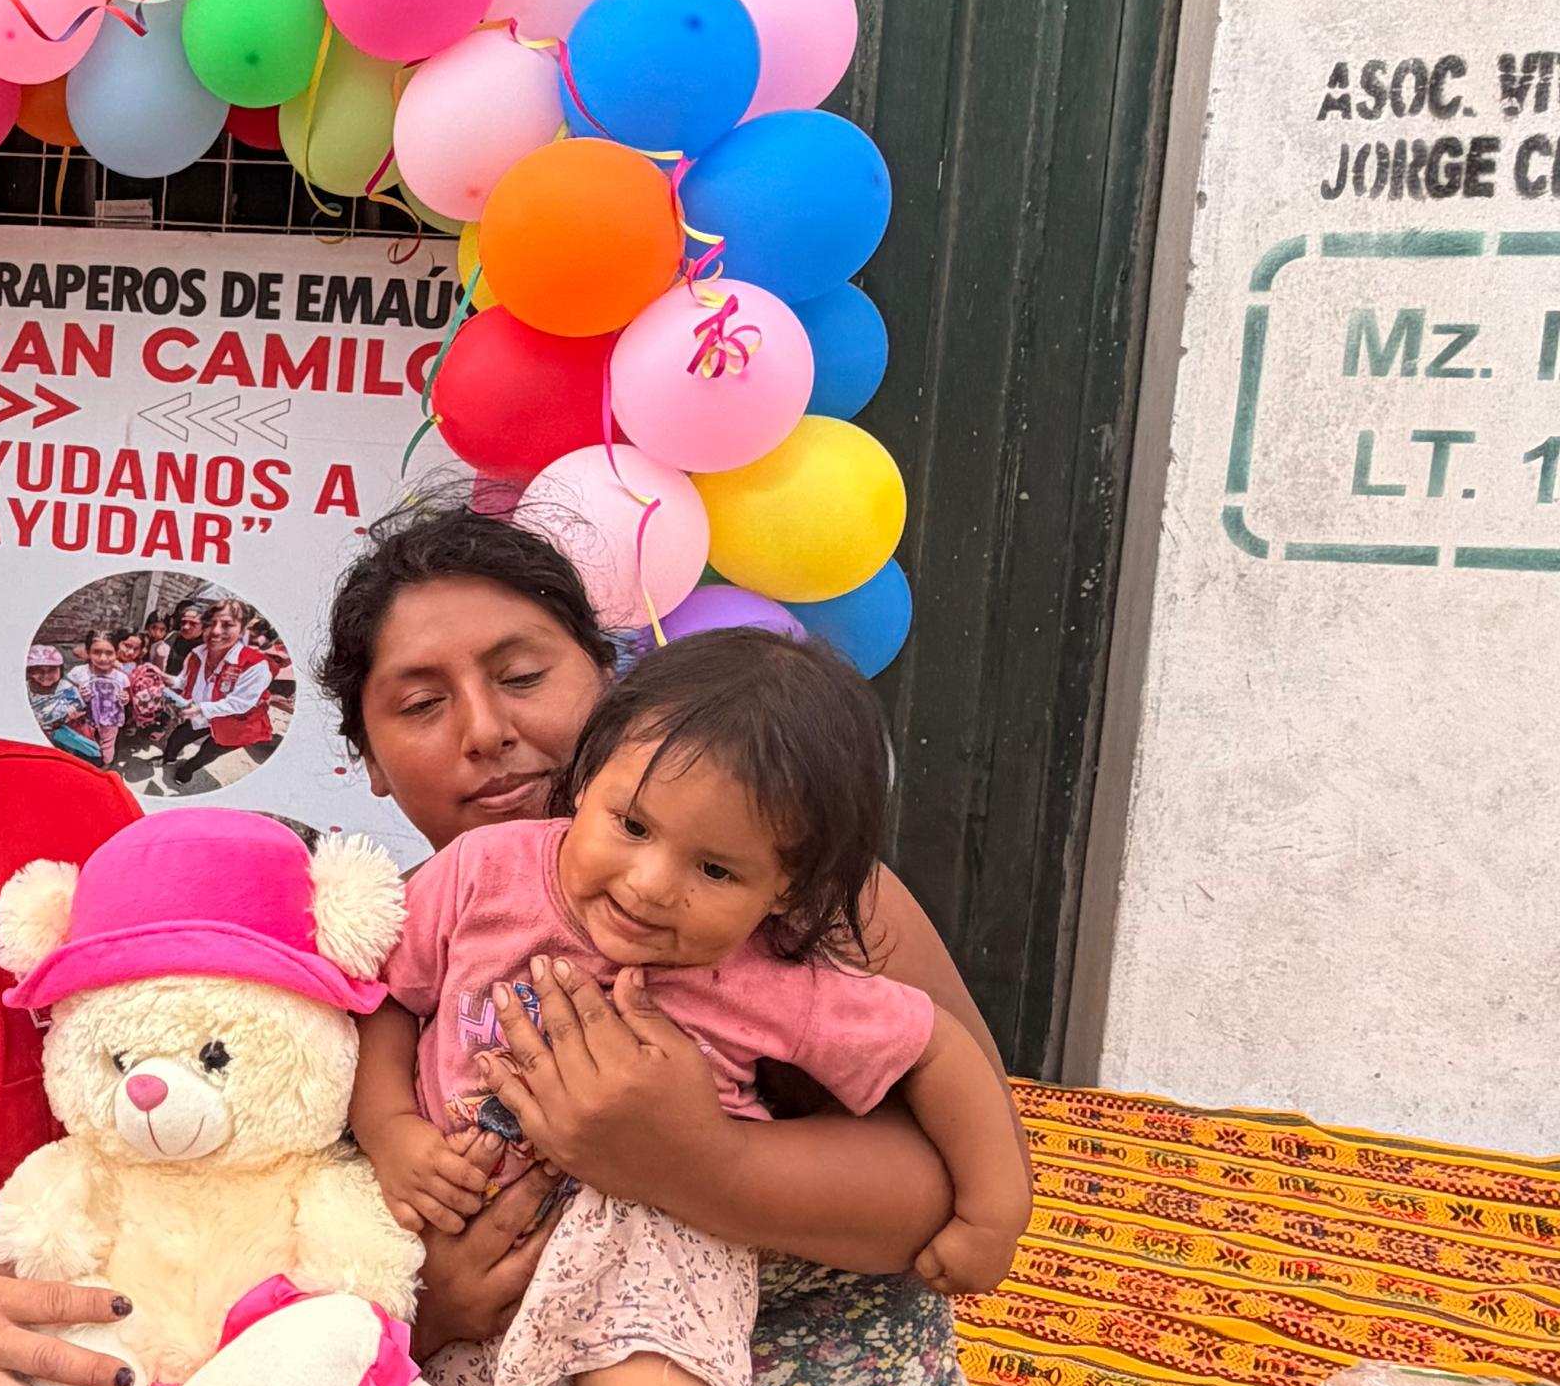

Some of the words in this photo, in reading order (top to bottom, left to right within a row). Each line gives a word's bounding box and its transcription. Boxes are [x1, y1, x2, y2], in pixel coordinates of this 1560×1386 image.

[1317, 55, 1477, 121] ASOC.
[1320, 137, 1501, 200] JORGE
[220, 270, 284, 320] DE
[314, 464, 360, 517] A
[1351, 430, 1477, 499] LT.
